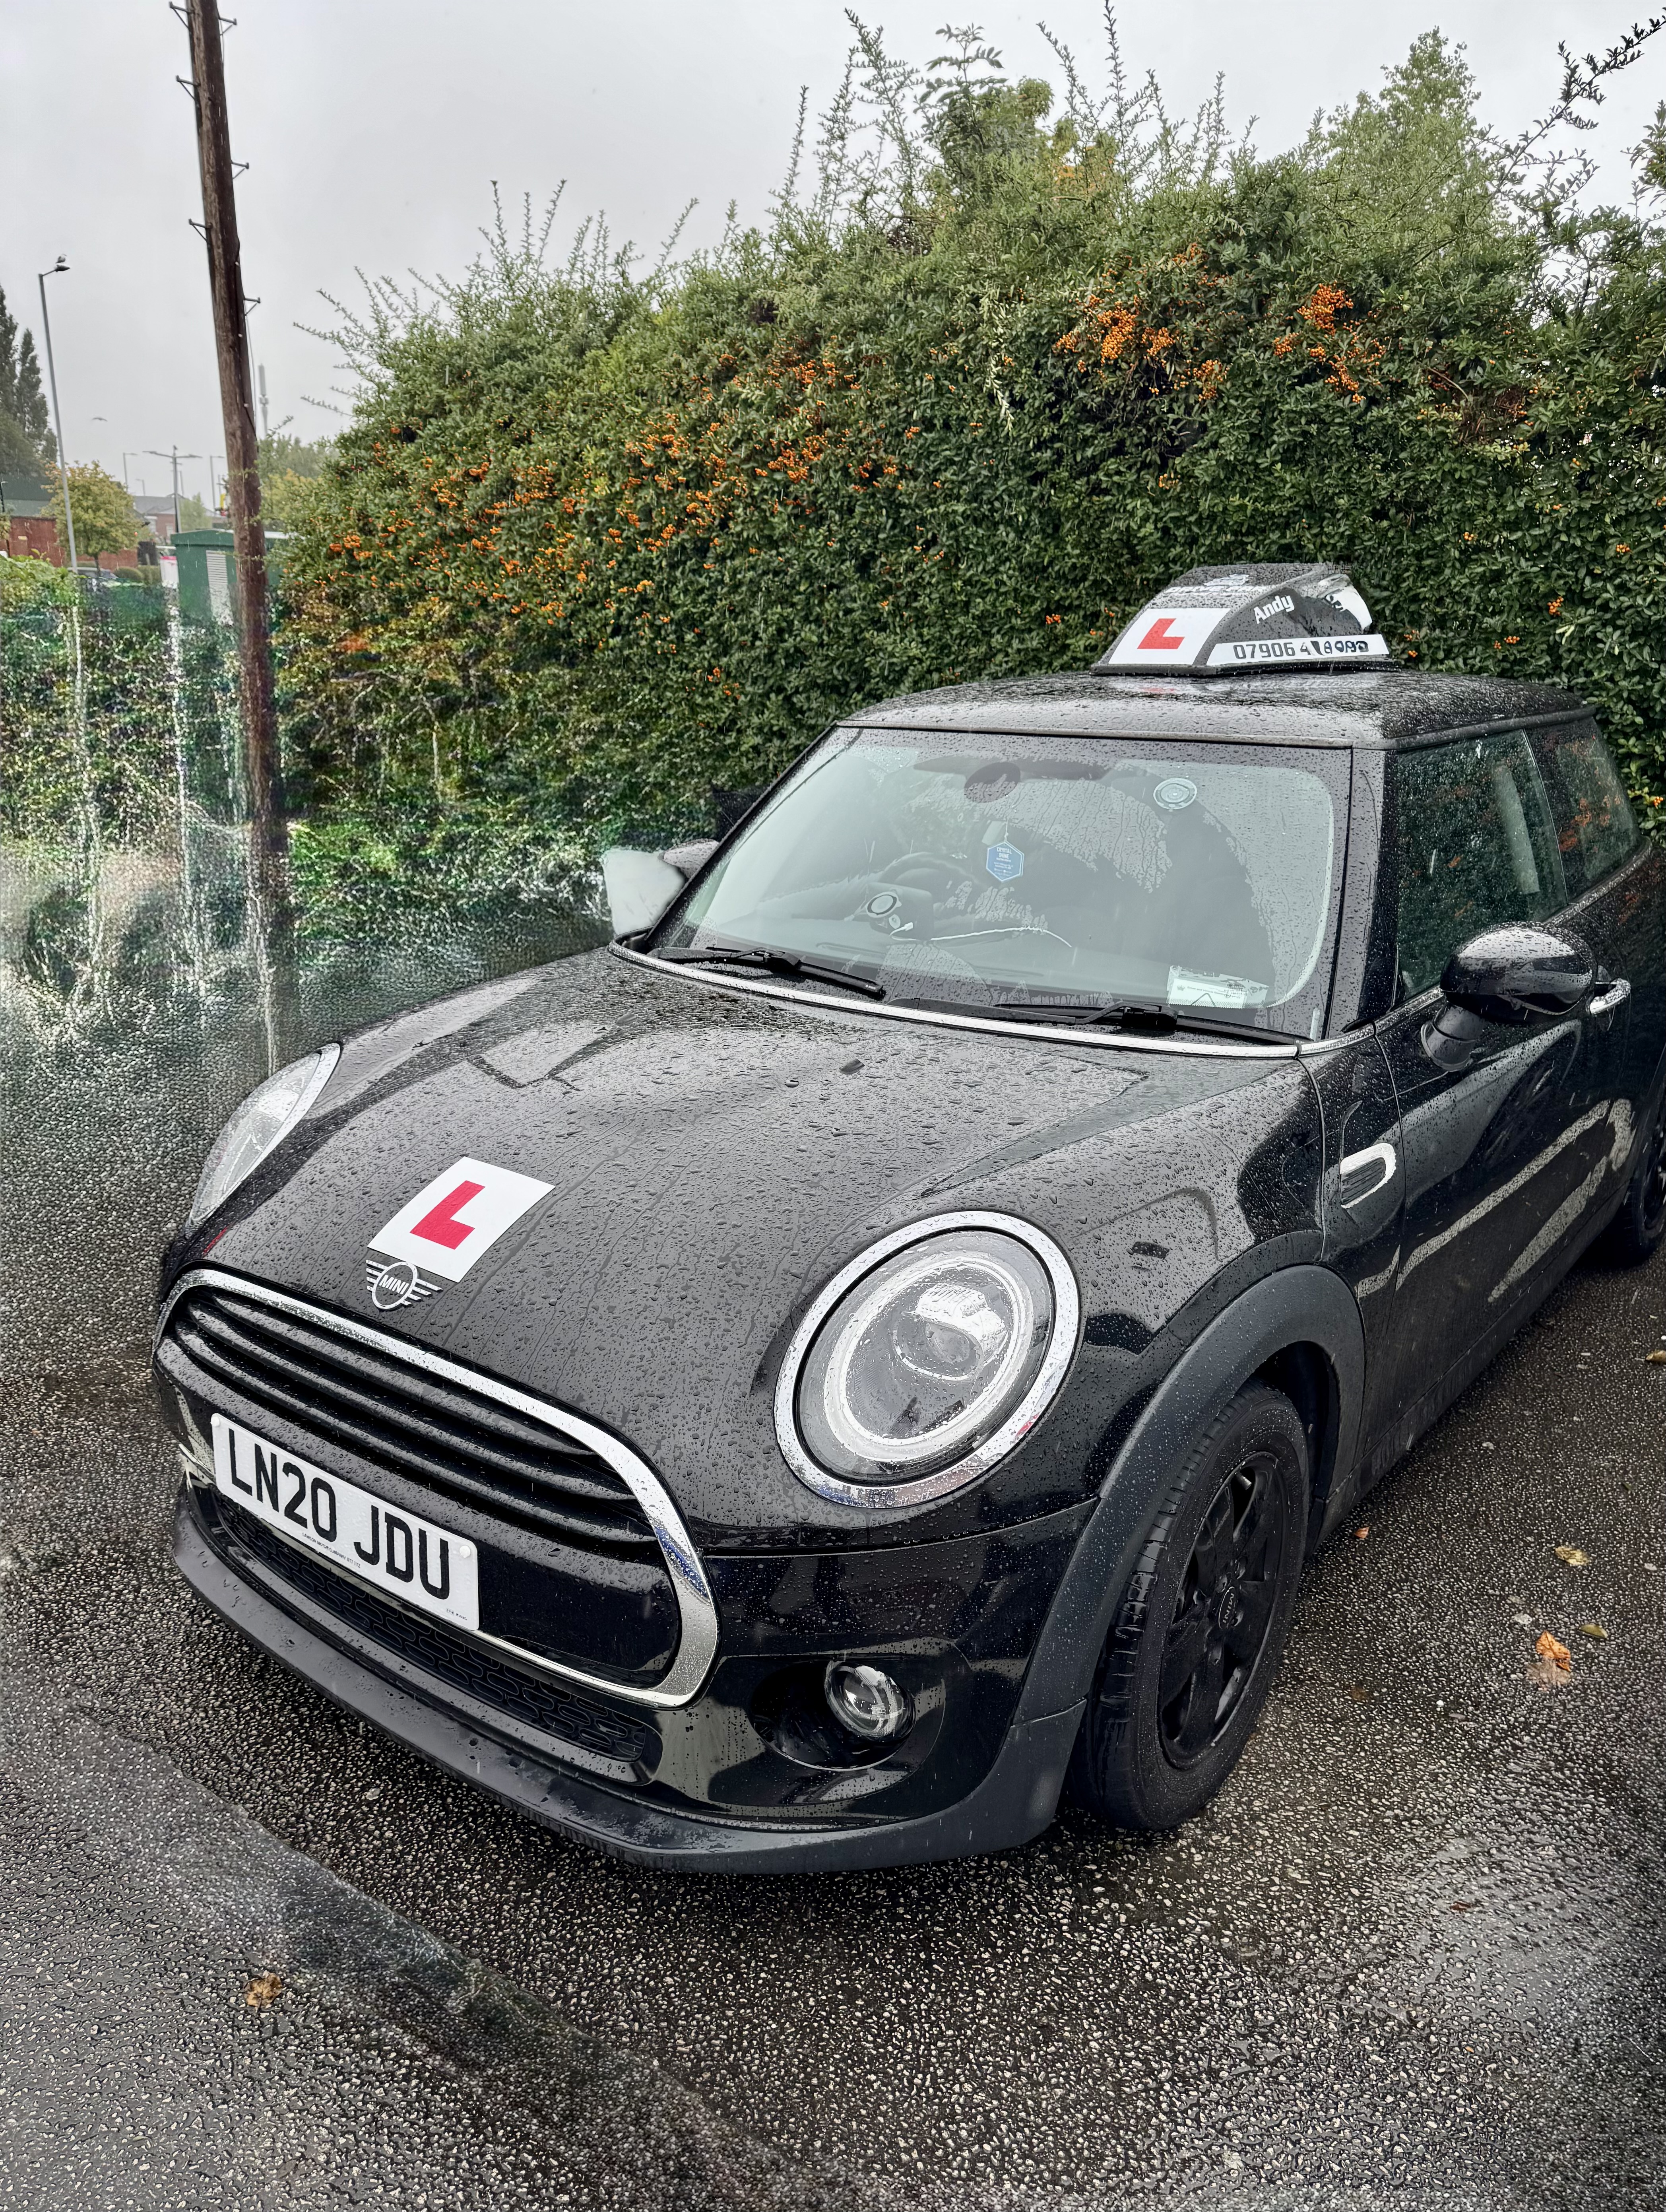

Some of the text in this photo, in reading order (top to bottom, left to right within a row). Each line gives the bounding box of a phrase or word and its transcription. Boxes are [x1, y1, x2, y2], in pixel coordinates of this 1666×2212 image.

[1253, 595, 1295, 624] Andy
[1137, 618, 1185, 650] L
[1233, 642, 1296, 659] 07906
[409, 1180, 486, 1250] L
[379, 1274, 409, 1295] MINI
[228, 1428, 450, 1600] LN20 JDU
[1222, 1593, 1234, 1623] MINI
